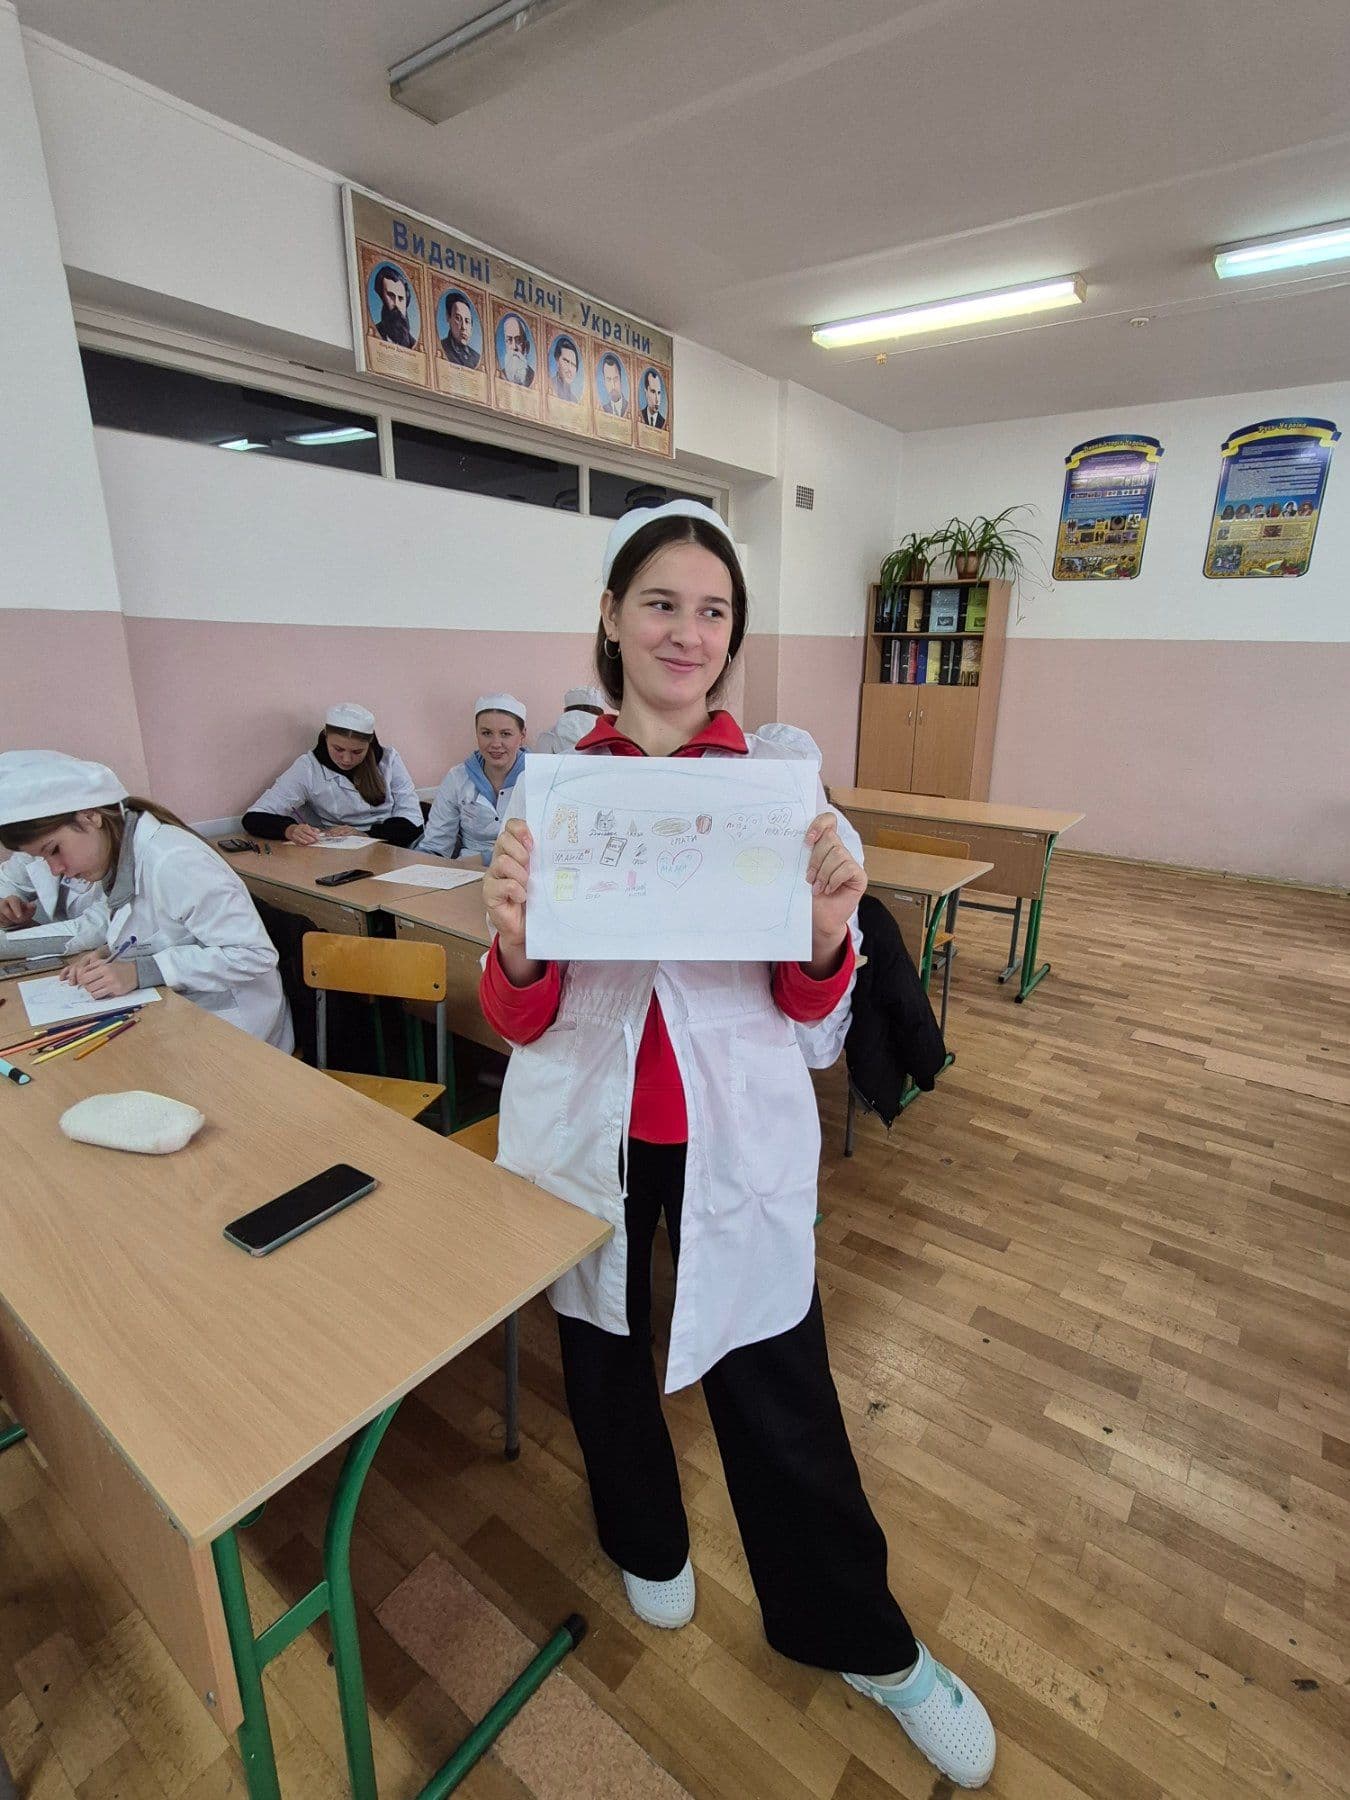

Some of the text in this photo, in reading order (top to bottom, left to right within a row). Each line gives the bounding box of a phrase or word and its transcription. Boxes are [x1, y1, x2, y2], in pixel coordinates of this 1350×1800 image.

[392, 220, 651, 355] Видатні діячі України
